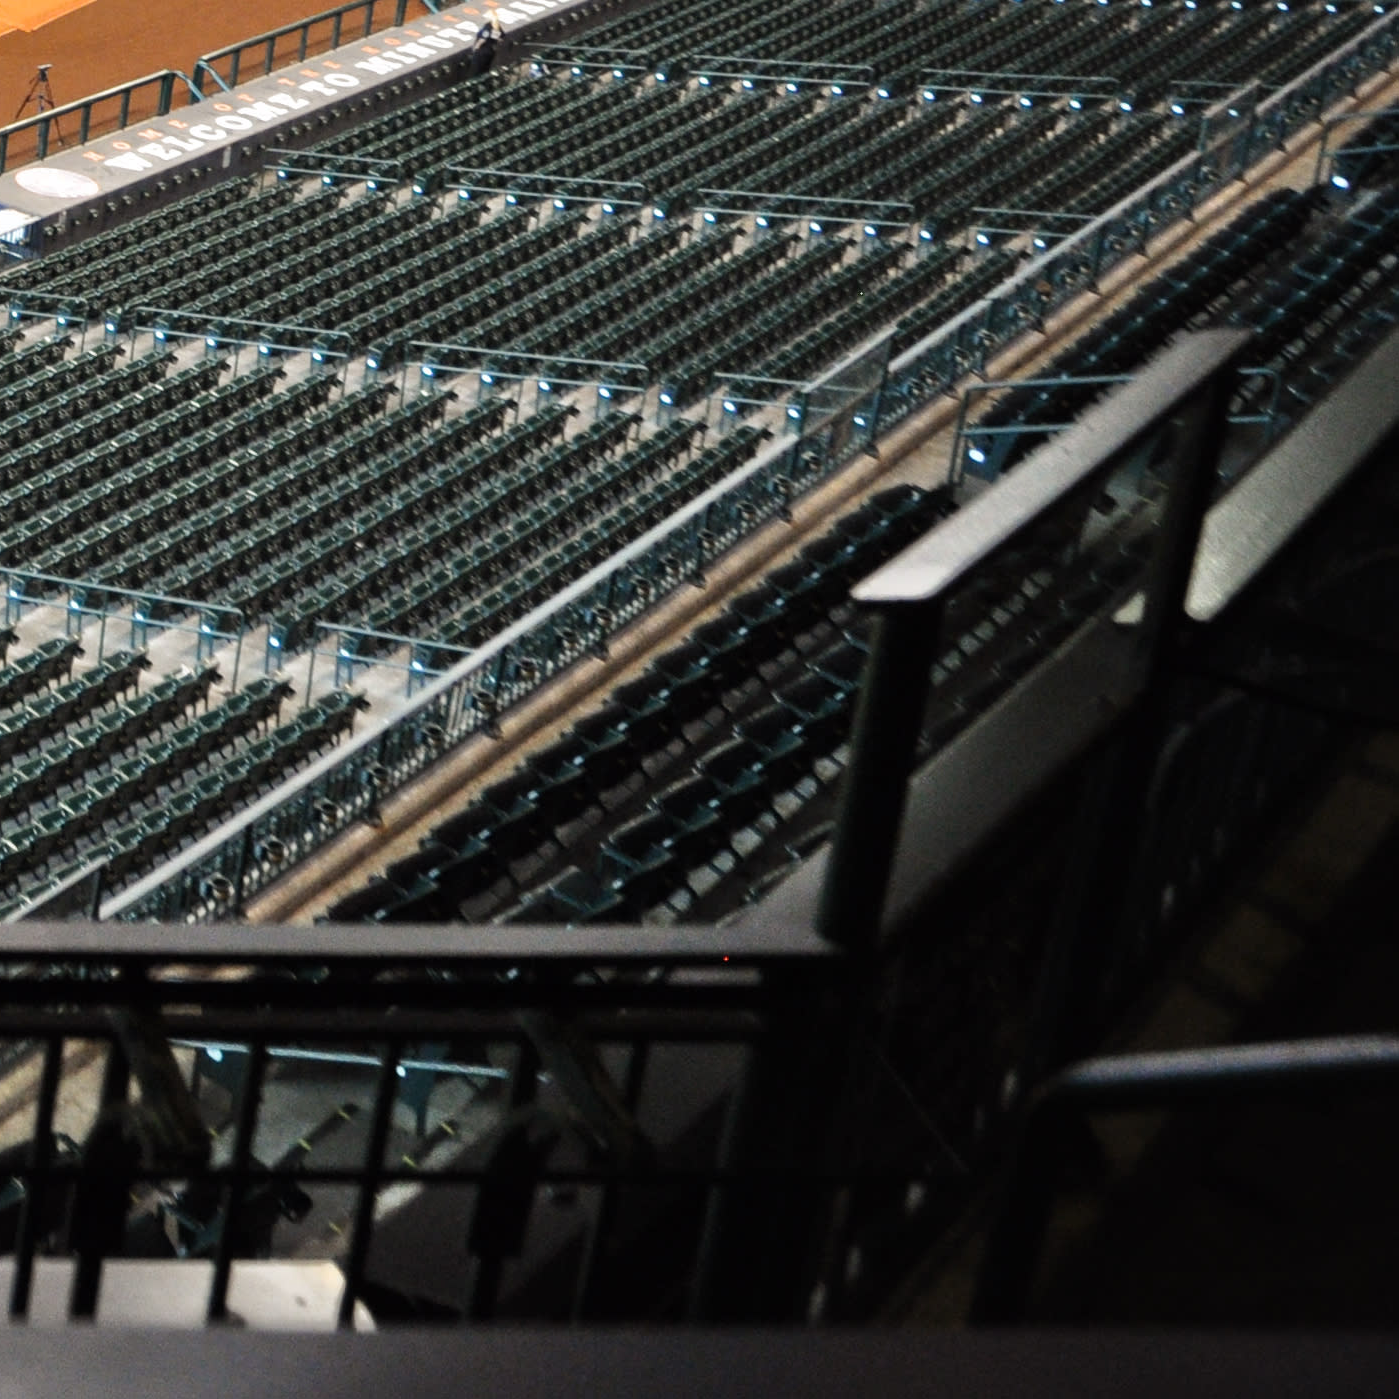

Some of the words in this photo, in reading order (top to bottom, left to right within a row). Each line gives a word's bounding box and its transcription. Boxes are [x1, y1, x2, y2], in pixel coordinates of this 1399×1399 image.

[82, 118, 189, 163] HOME
[213, 93, 256, 113] OF
[103, 92, 310, 172] WELCOME
[299, 72, 361, 97] TO
